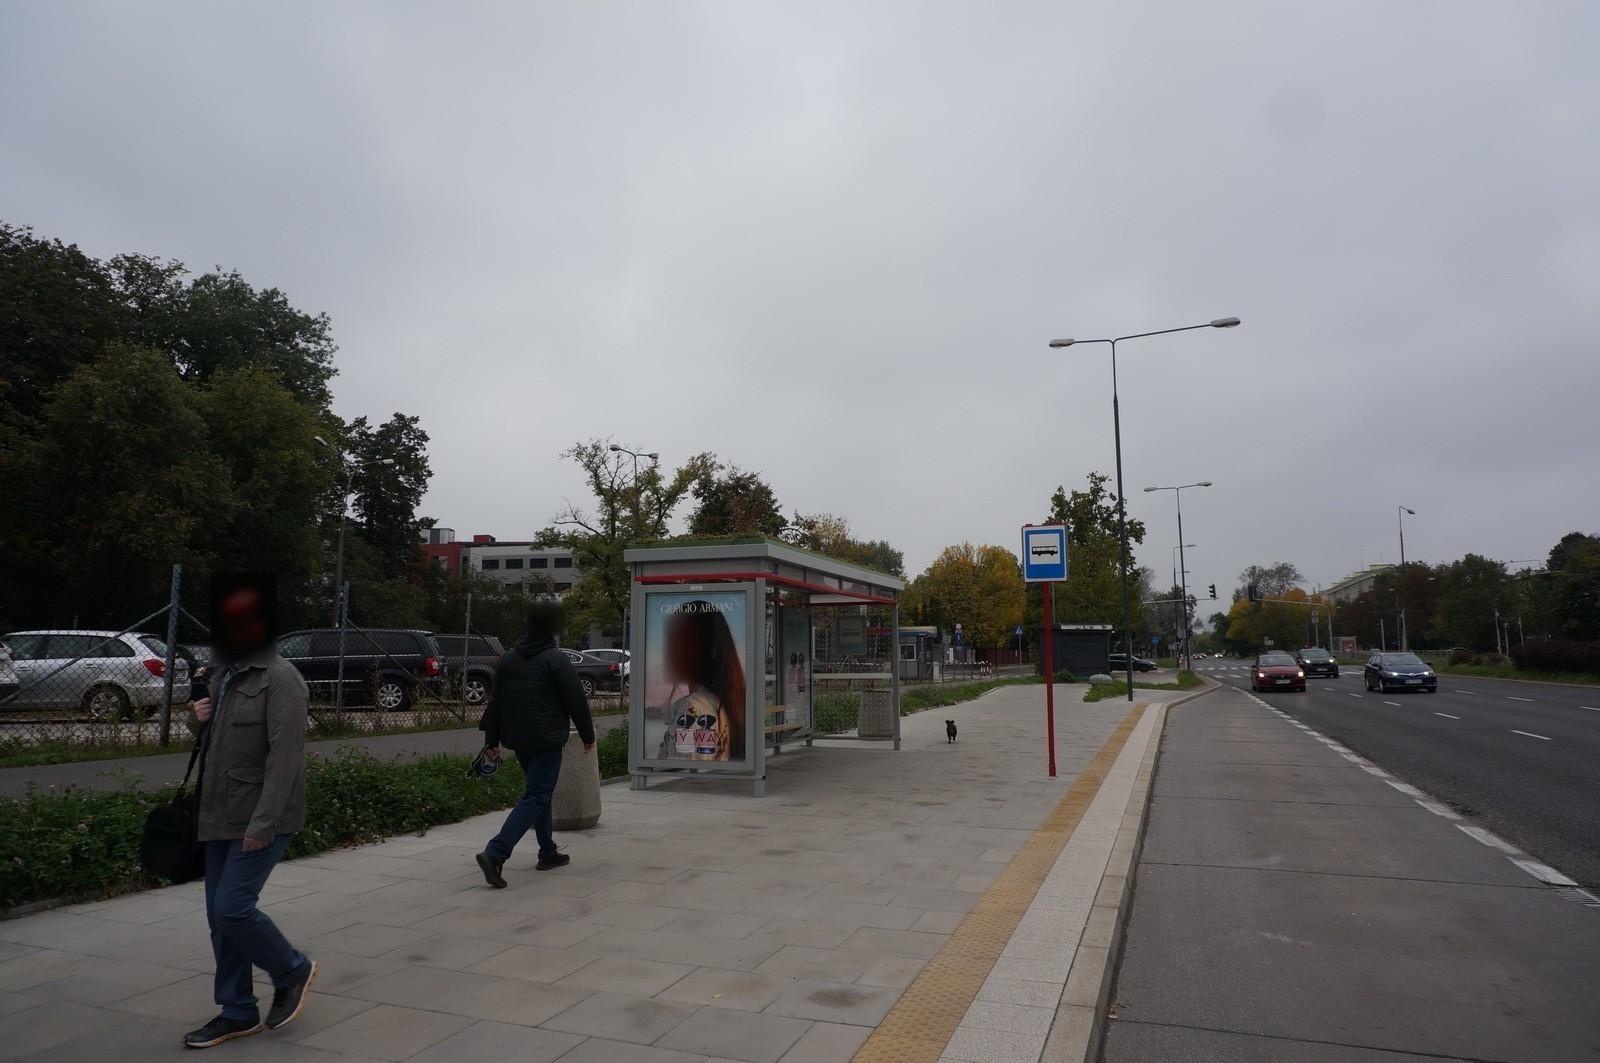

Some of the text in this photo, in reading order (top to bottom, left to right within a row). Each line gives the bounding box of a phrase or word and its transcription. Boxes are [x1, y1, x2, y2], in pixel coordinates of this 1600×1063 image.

[660, 602, 733, 614] GIORGIO ARMANI
[667, 733, 723, 744] MY WAY
